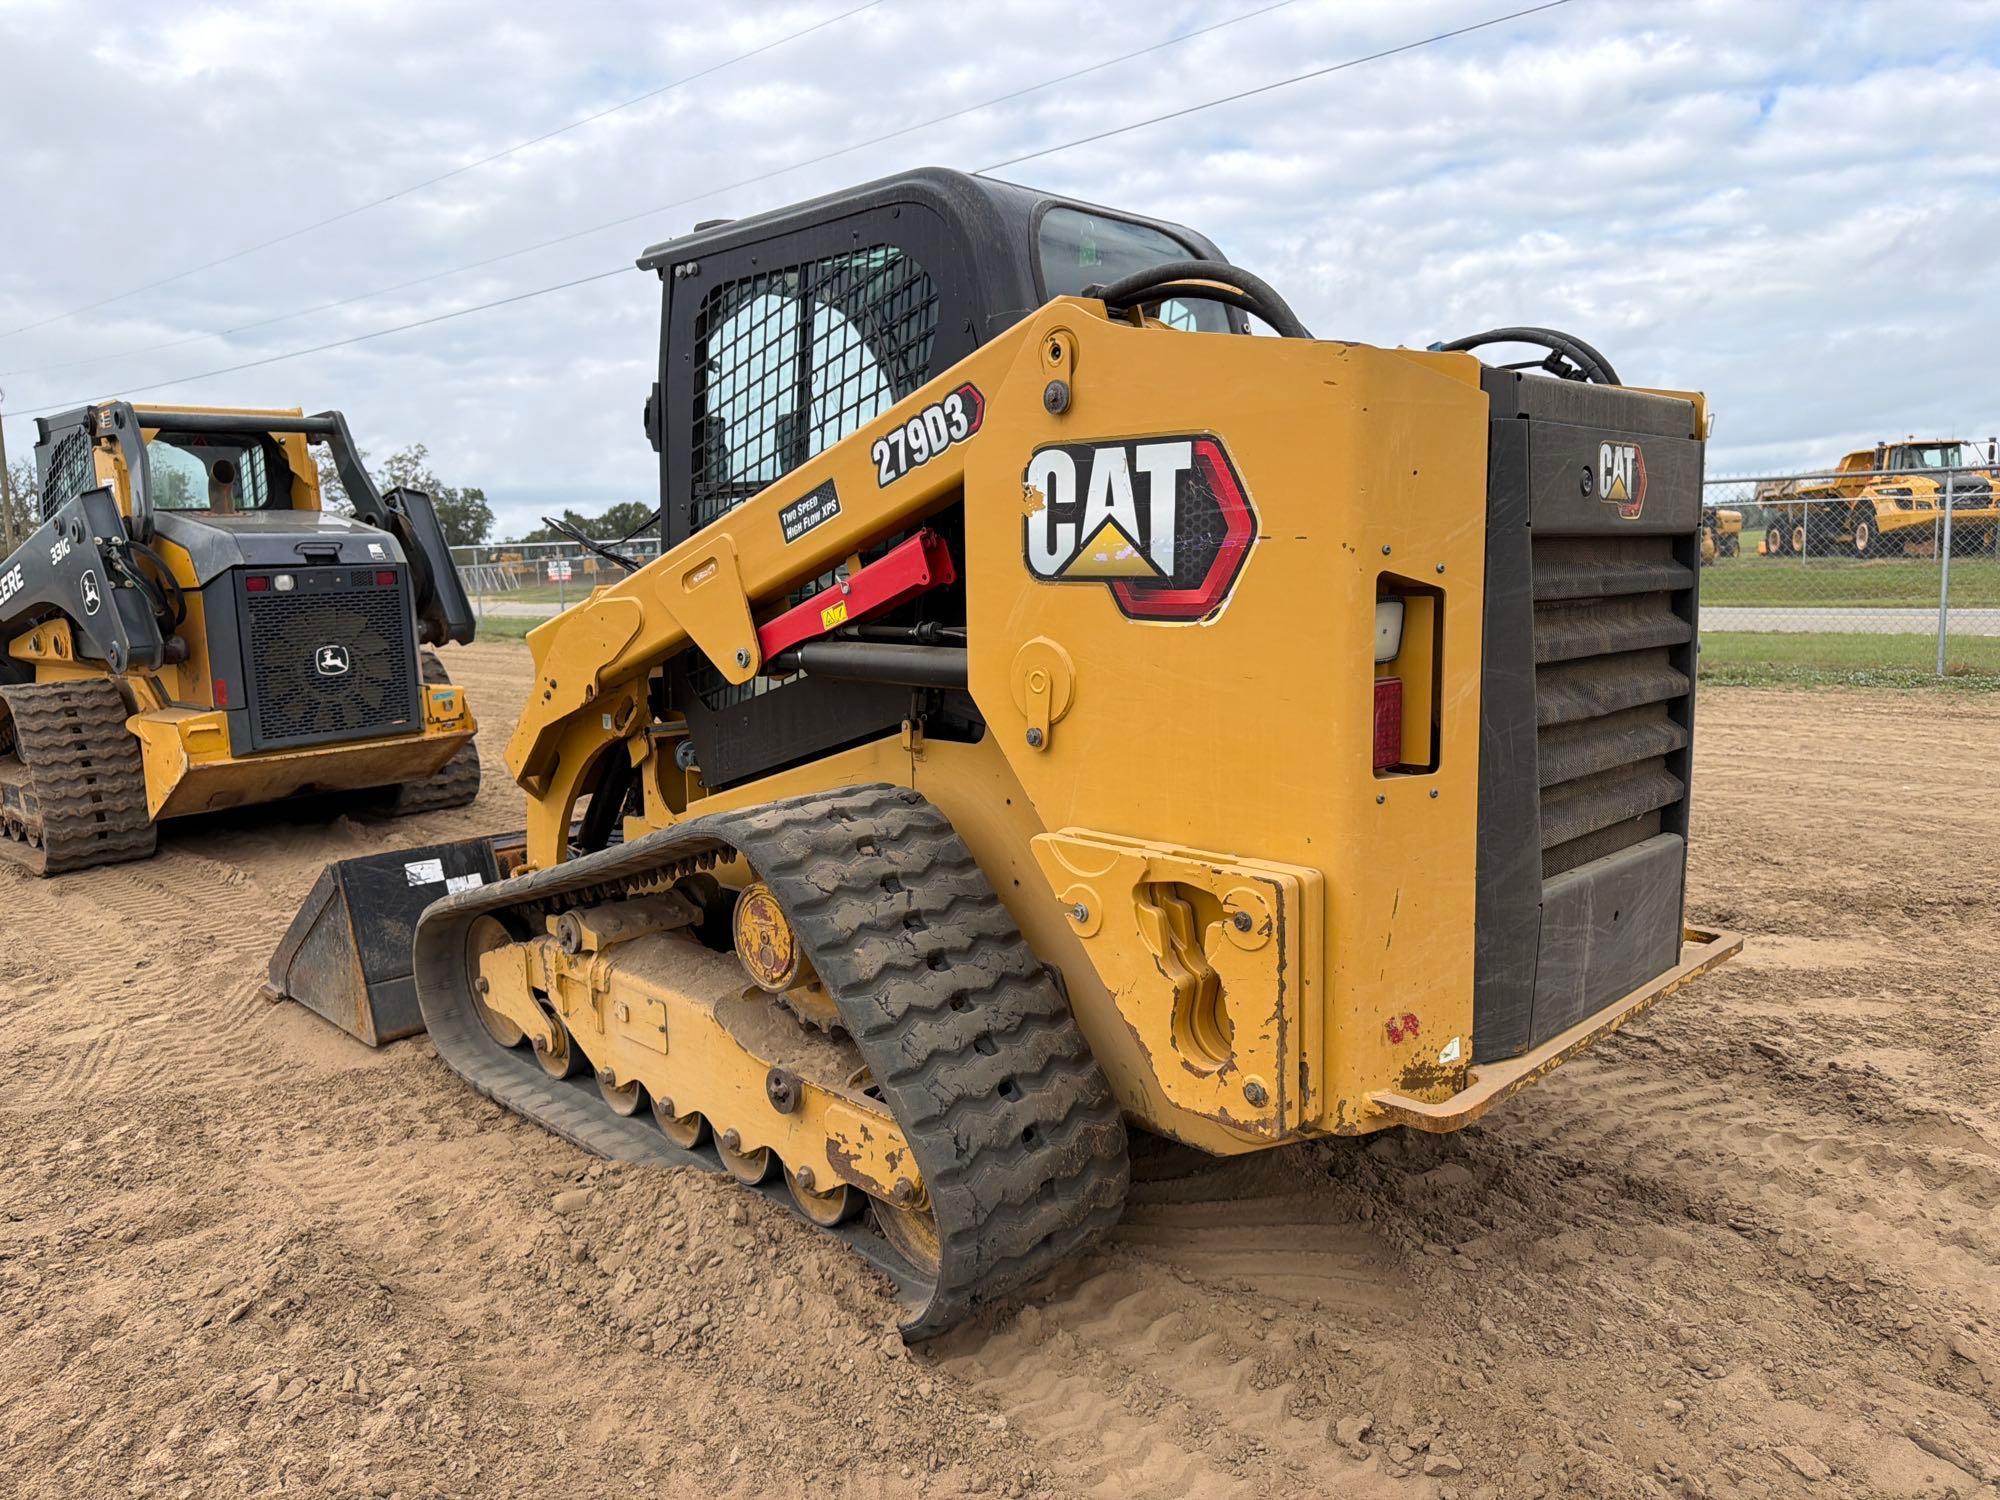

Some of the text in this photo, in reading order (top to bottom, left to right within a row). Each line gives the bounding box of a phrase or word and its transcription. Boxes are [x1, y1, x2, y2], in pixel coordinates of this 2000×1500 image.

[873, 393, 969, 486] 279D3
[1600, 443, 1635, 500] CAT
[821, 498, 837, 518] XPS
[1027, 441, 1192, 576] CAT
[50, 537, 71, 566] 331G
